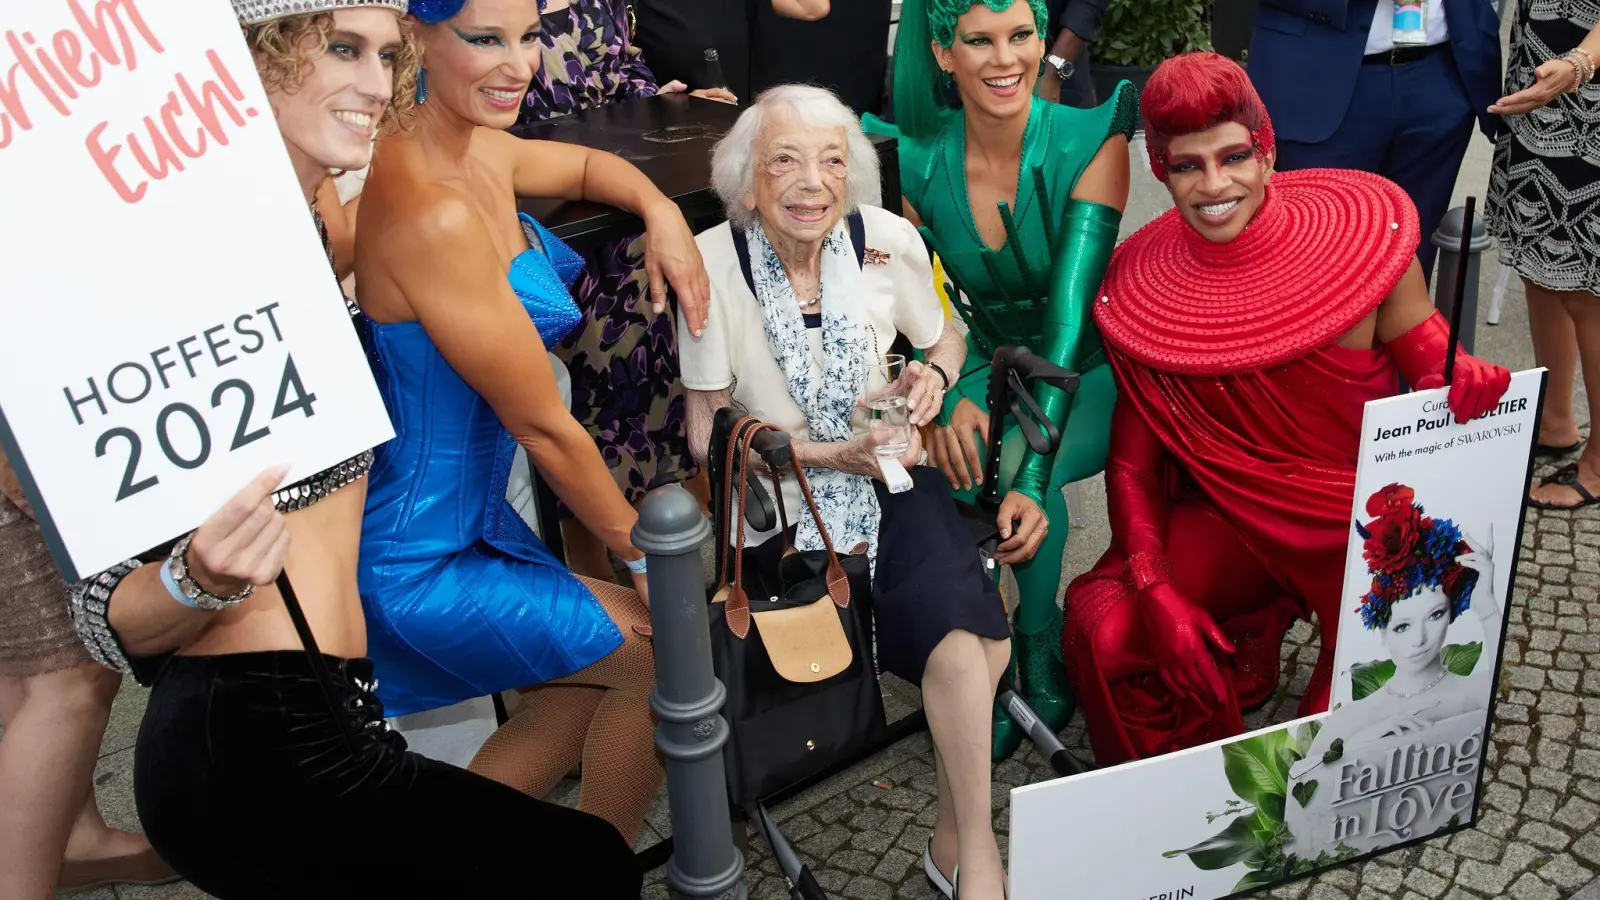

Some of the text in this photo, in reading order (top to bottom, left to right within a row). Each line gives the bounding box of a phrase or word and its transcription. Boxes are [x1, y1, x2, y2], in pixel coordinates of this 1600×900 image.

[0, 0, 165, 149] rliebt
[85, 49, 259, 204] Euch!
[63, 302, 286, 426] HOFFEST
[94, 351, 317, 503] 2024
[1373, 425, 1411, 442] Jean
[1416, 412, 1450, 433] Paul
[1374, 423, 1522, 464] With the magic of SWAROVSKI
[1422, 400, 1449, 413] Cura
[1331, 726, 1483, 802] Falling
[1326, 780, 1473, 844] in Love
